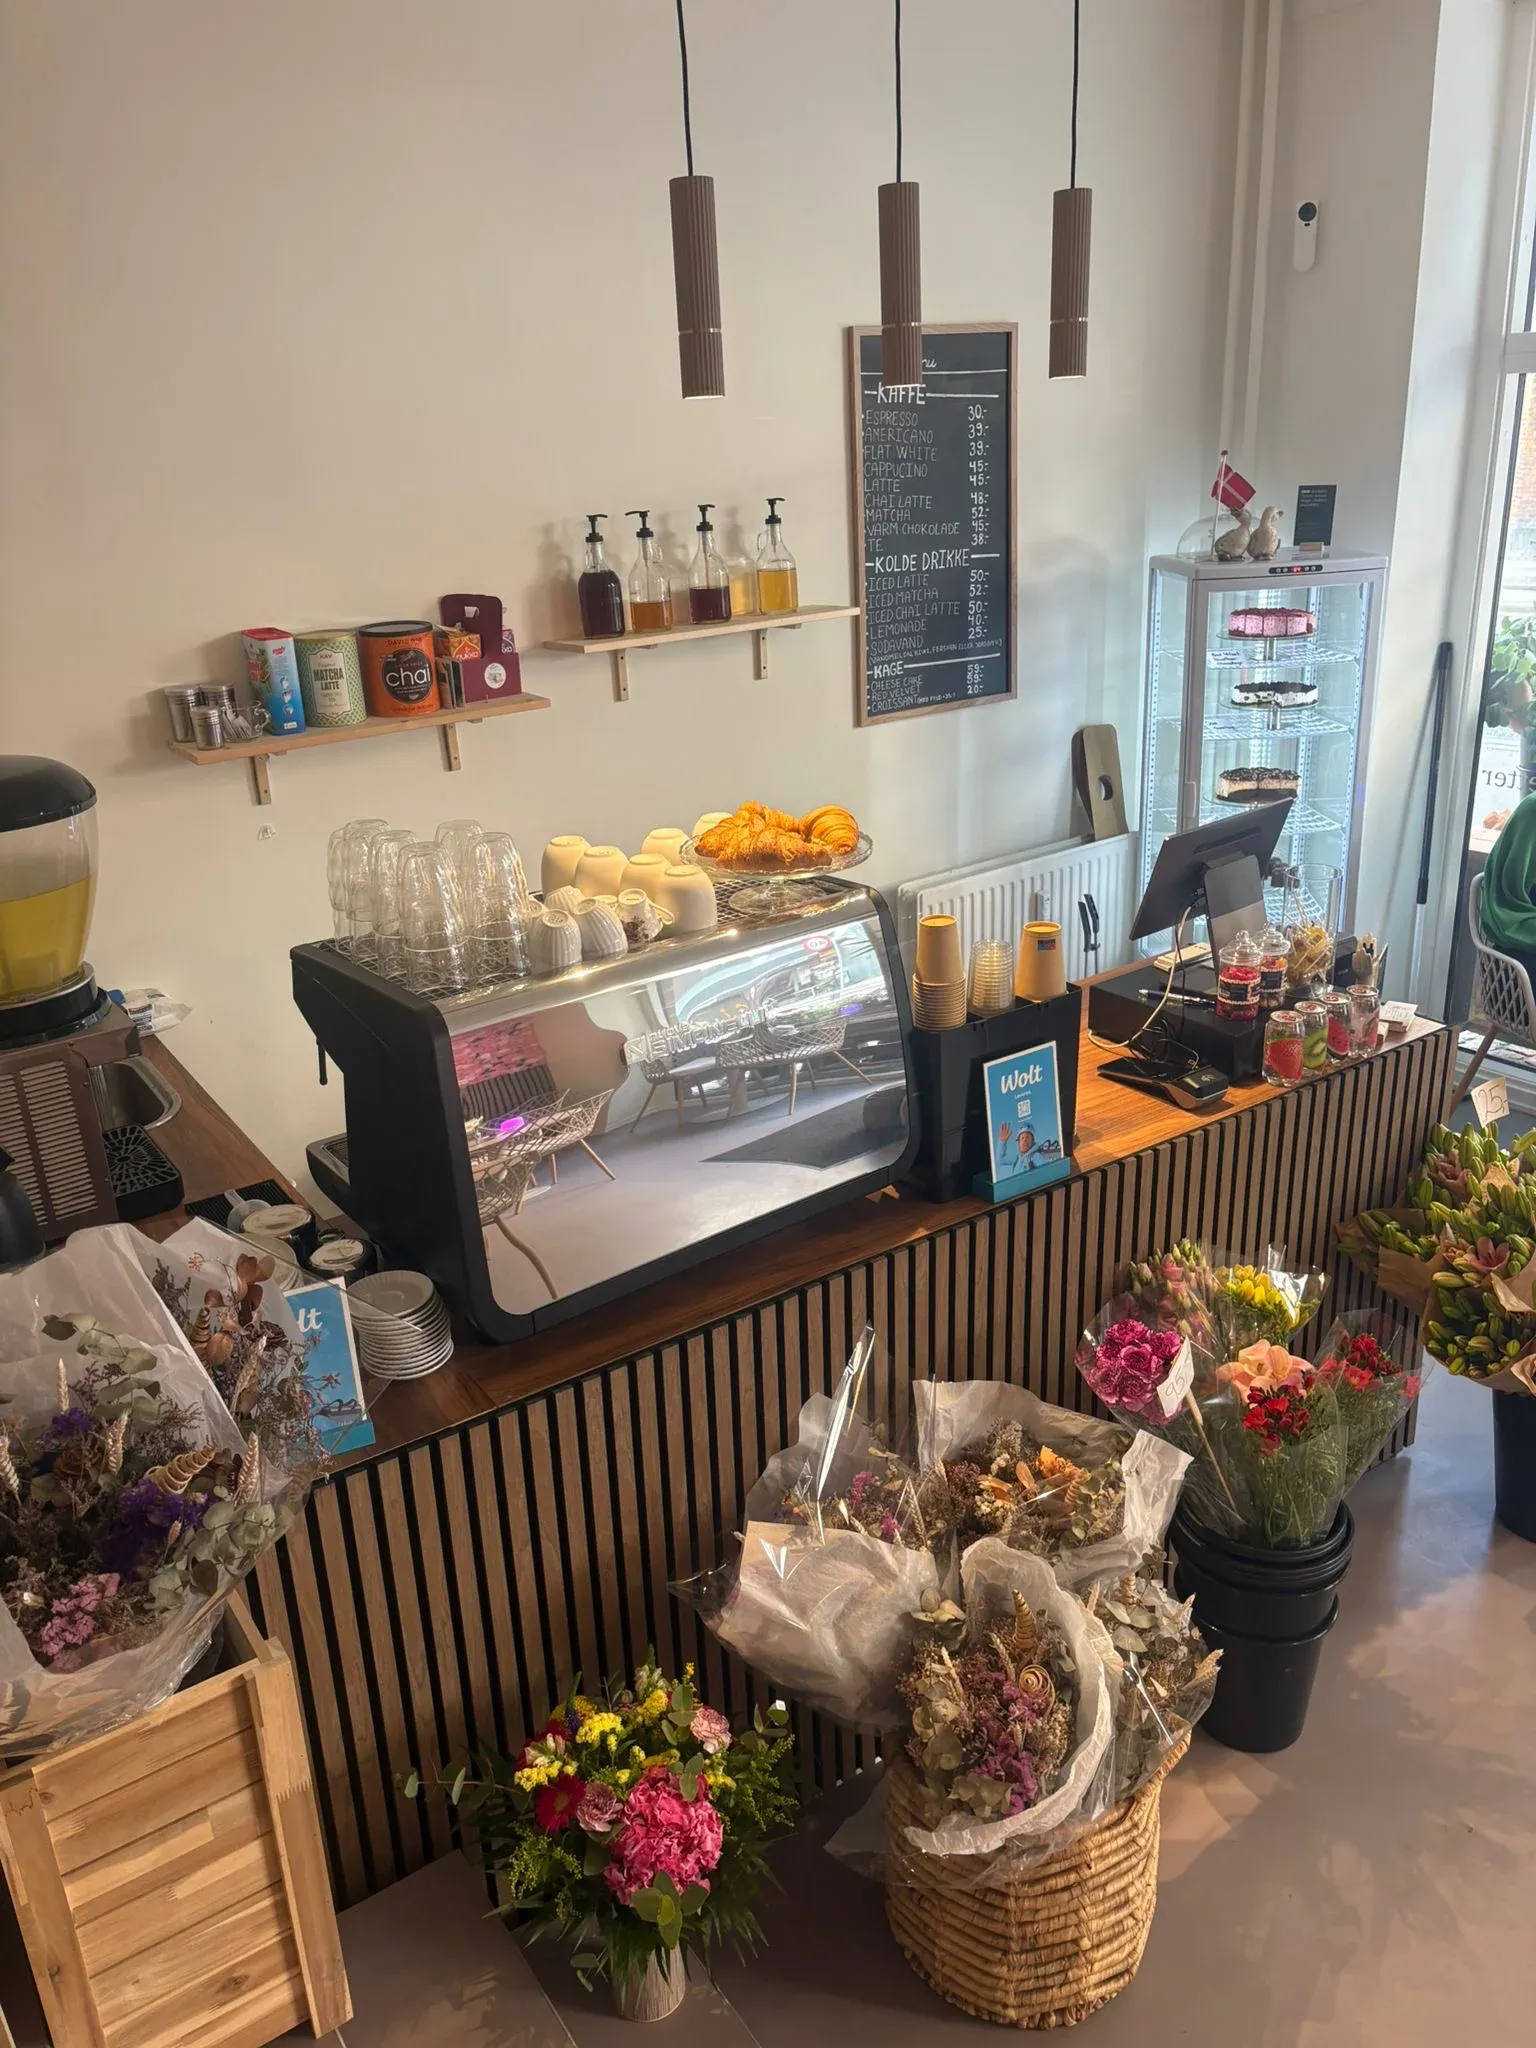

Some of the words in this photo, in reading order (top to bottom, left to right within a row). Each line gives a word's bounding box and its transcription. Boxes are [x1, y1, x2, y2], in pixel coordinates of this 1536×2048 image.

[877, 382, 926, 404] KAFFE
[866, 409, 919, 427] ESPRESSO
[865, 427, 934, 444] AMERICANO
[864, 444, 892, 460] FLAT
[896, 445, 938, 462] WHITE
[864, 461, 928, 478] CAPPUCINO
[864, 478, 901, 492] LATTE
[864, 493, 895, 508] CHAI
[898, 495, 933, 509] LATTE
[865, 508, 911, 522] MATCHA
[866, 522, 899, 536] VARM
[901, 522, 960, 535] CHOKOLADE
[867, 538, 884, 552] TE
[875, 554, 918, 574] KOLDE
[922, 548, 970, 571] DRIKKE
[868, 577, 895, 592] ICED
[897, 574, 930, 589] LATTE
[868, 593, 894, 609] ICED
[895, 587, 939, 605] MATCHA
[868, 608, 894, 624] ICED
[896, 604, 921, 620] CHAI
[925, 601, 961, 616] LATTE
[870, 618, 927, 640] LEMONADE
[870, 635, 924, 657] SODAVAND
[312, 668, 345, 681] MATCHA
[386, 664, 431, 687] chai
[874, 660, 904, 679] KAGE
[320, 680, 340, 691] LATTE
[871, 678, 901, 691] CHEESE
[903, 675, 924, 686] CAKE
[872, 691, 888, 701] RED
[889, 685, 921, 698] VELVET
[872, 694, 919, 712] CROISSANT
[1000, 1064, 1044, 1095] Wolt
[297, 1307, 323, 1333] lt
